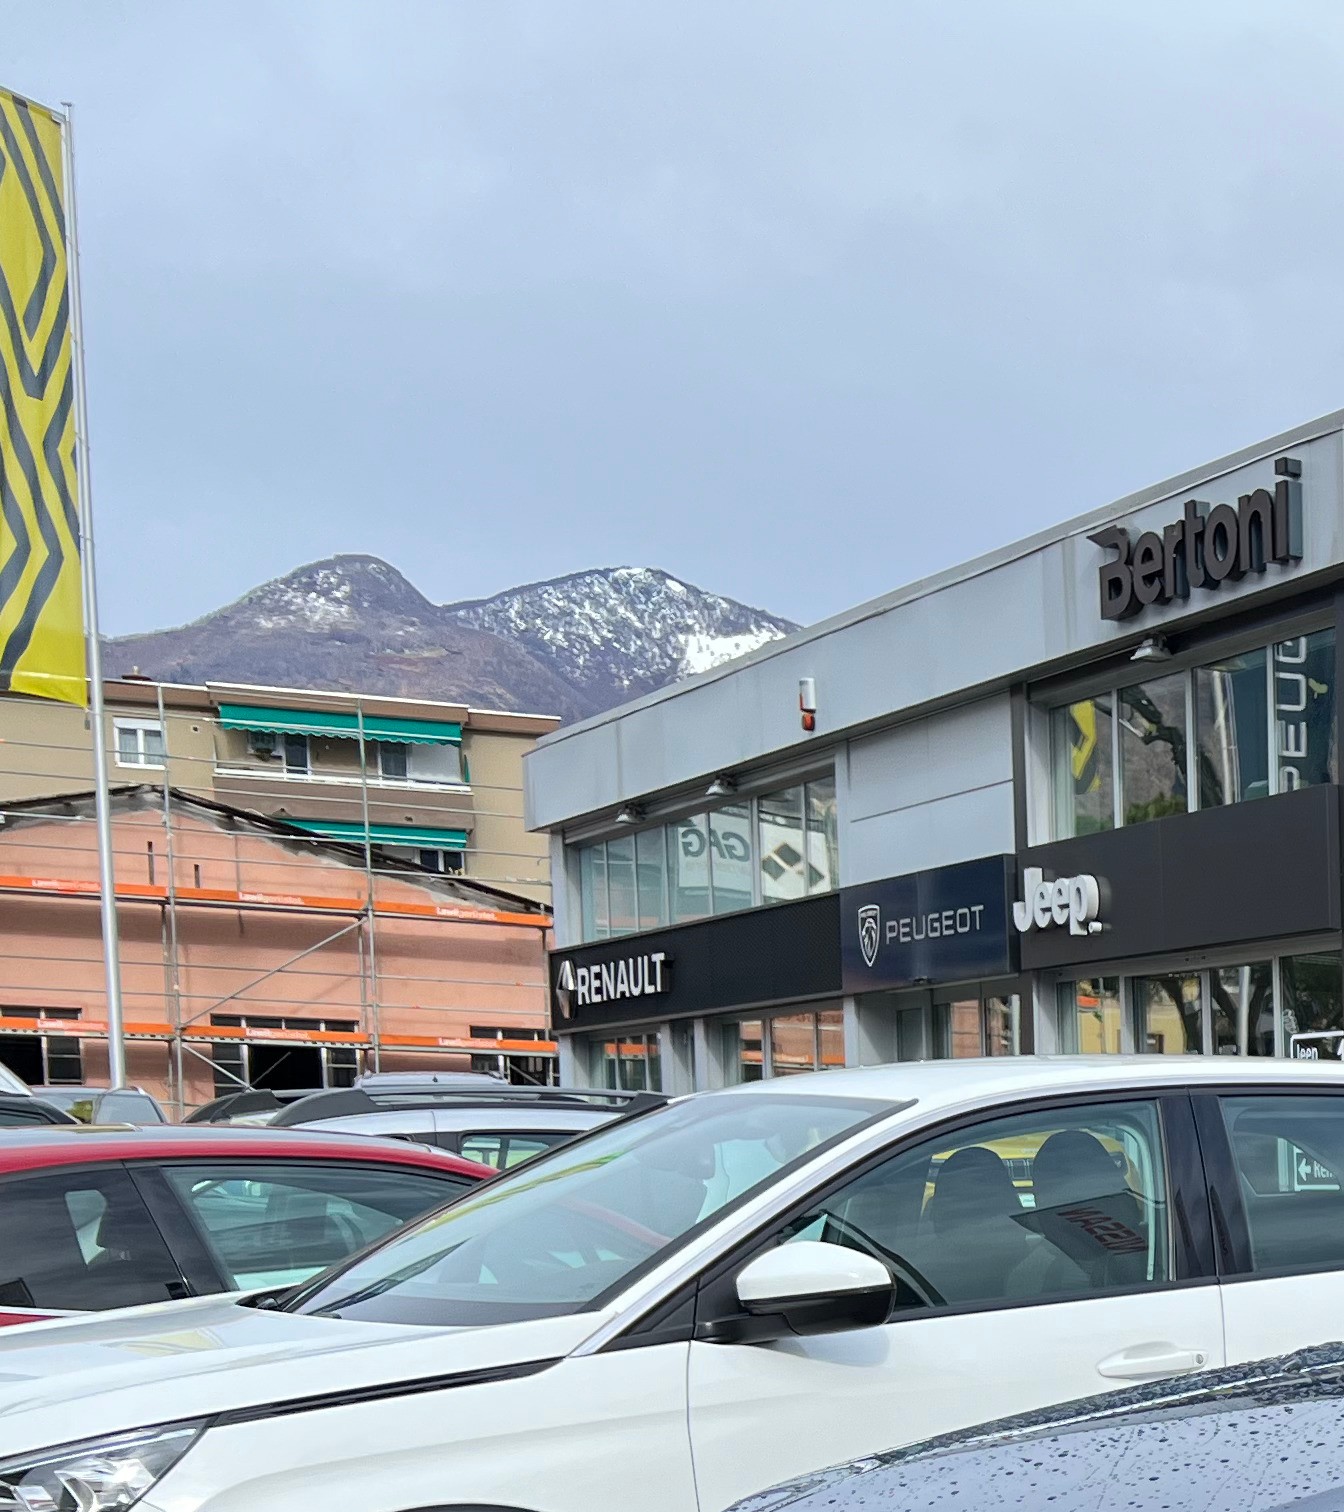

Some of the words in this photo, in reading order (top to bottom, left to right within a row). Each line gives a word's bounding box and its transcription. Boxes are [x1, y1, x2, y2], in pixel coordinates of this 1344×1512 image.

[1087, 457, 1302, 620] Bertoni
[886, 905, 984, 945] PEUGEOT
[1013, 867, 1100, 935] Jeep
[576, 952, 666, 1006] RENAULT
